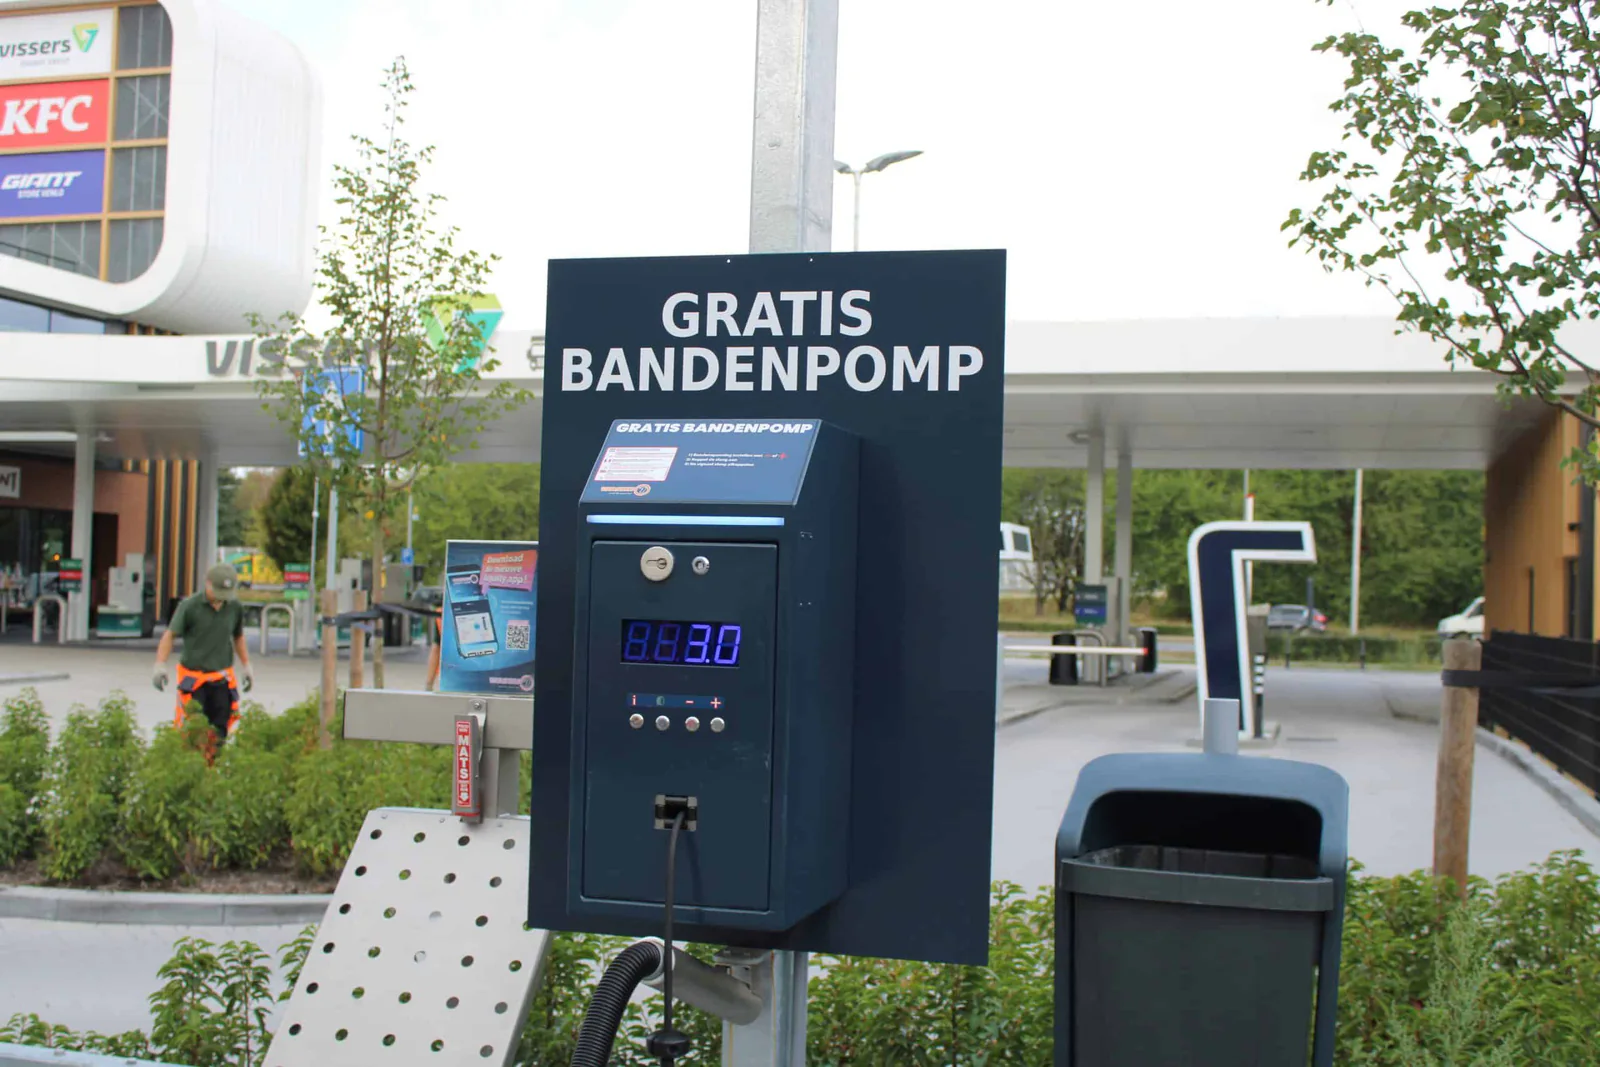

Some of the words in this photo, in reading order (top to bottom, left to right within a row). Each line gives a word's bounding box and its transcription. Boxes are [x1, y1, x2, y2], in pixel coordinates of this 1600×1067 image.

[0, 40, 71, 58] vissers
[0, 95, 93, 136] KFC
[1, 171, 82, 189] GIANT
[661, 289, 873, 338] GRATIS
[561, 345, 984, 392] BANDENPOMP
[616, 423, 681, 433] GRATIS
[682, 423, 813, 434] BANDENPOMP
